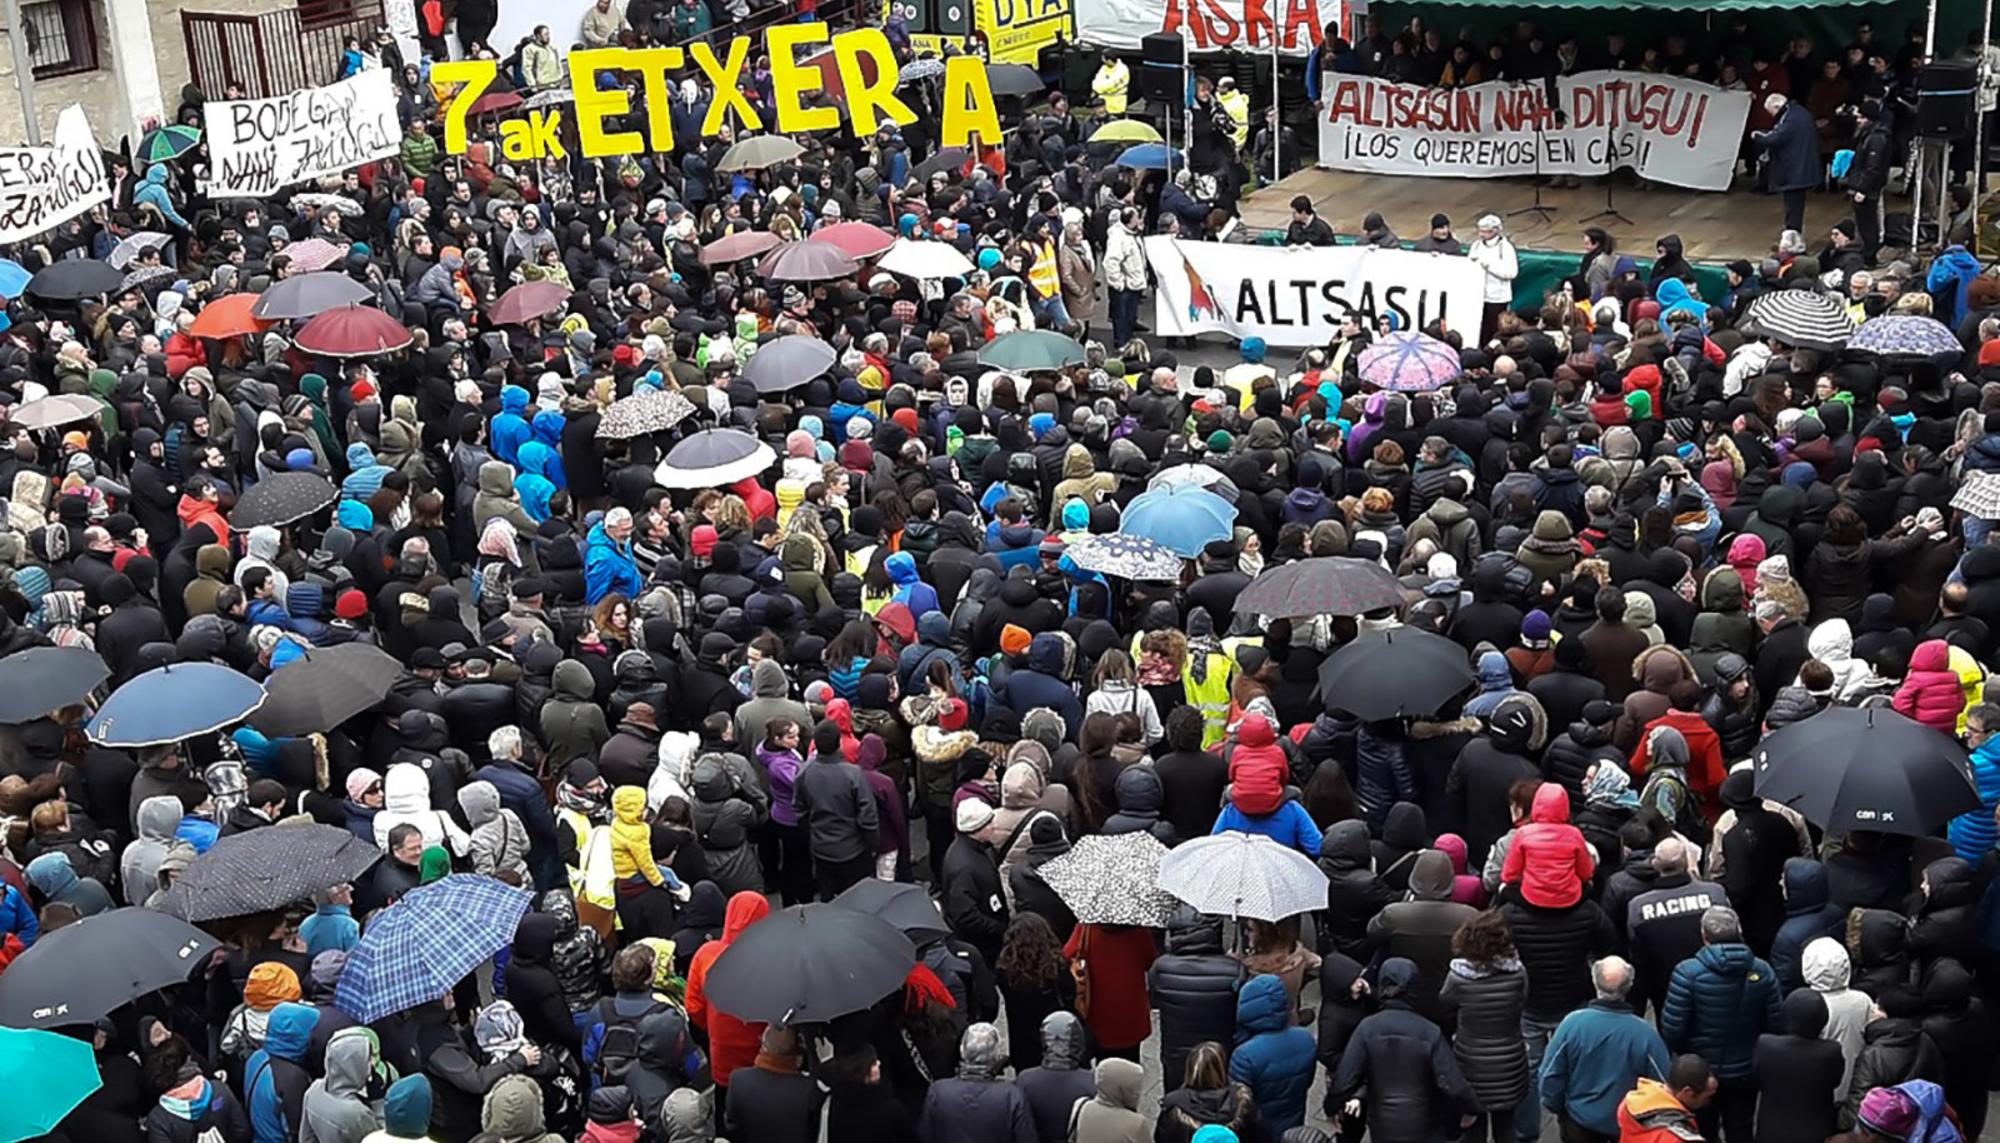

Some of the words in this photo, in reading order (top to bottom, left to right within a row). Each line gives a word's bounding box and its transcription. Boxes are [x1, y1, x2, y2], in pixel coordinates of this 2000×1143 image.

[1329, 81, 1480, 132] ALTSASUN
[1573, 80, 1709, 148] DITUGU!
[1414, 137, 1536, 167] QUEREMOS
[1548, 139, 1575, 164] EN
[1587, 132, 1650, 172] CAS!
[1236, 278, 1447, 331] ALTSASU
[1642, 893, 1711, 920] RACING
